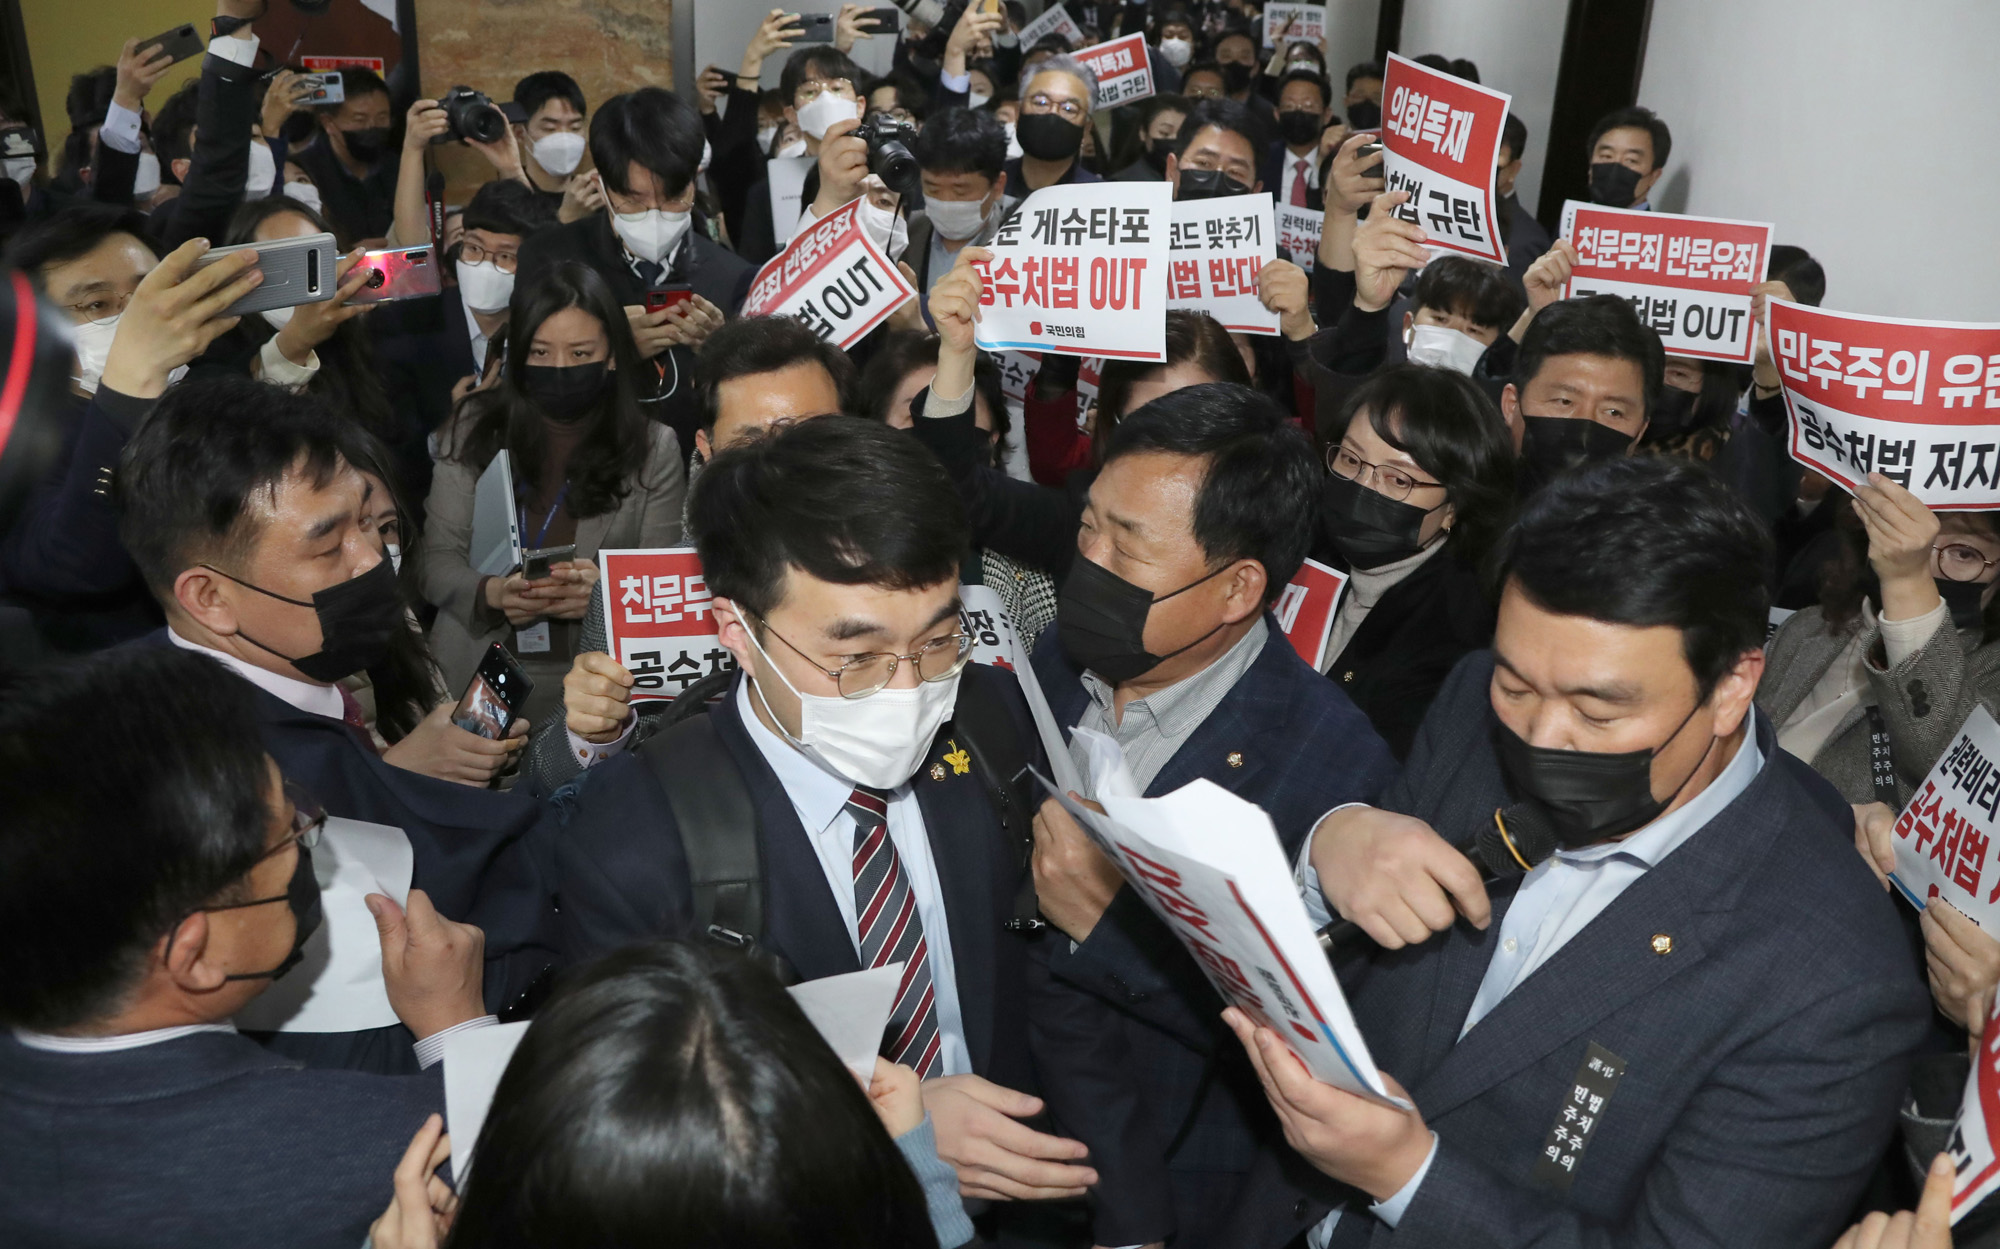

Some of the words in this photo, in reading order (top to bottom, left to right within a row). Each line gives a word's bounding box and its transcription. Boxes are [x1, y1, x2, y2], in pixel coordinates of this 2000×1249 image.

[1122, 74, 1146, 95] 규탄
[1387, 86, 1475, 164] 의회독재
[986, 211, 1023, 246] 문
[1031, 207, 1150, 246] 게슈타포
[1206, 215, 1261, 250] 맞추기
[1427, 190, 1484, 242] 규탄
[784, 208, 854, 286] 반문유죄
[1577, 226, 1664, 273] 친문무죄
[1666, 236, 1758, 282] 반문유죄
[822, 256, 884, 320] OUT
[970, 256, 1079, 309] 공수처법
[1090, 257, 1147, 310] OUT
[1208, 255, 1262, 297] 반대
[1045, 324, 1085, 338] 국민의힘
[1683, 304, 1746, 343] OUT
[1778, 329, 1930, 405] 민주주의
[1797, 403, 1916, 491] 공수처법
[1872, 733, 1884, 787] 민주주의
[1939, 734, 2000, 823] 권력비리
[1895, 780, 1990, 898] 공수처법
[1545, 1084, 1589, 1163] 민주주의
[1560, 1093, 1604, 1172] 법치주의
